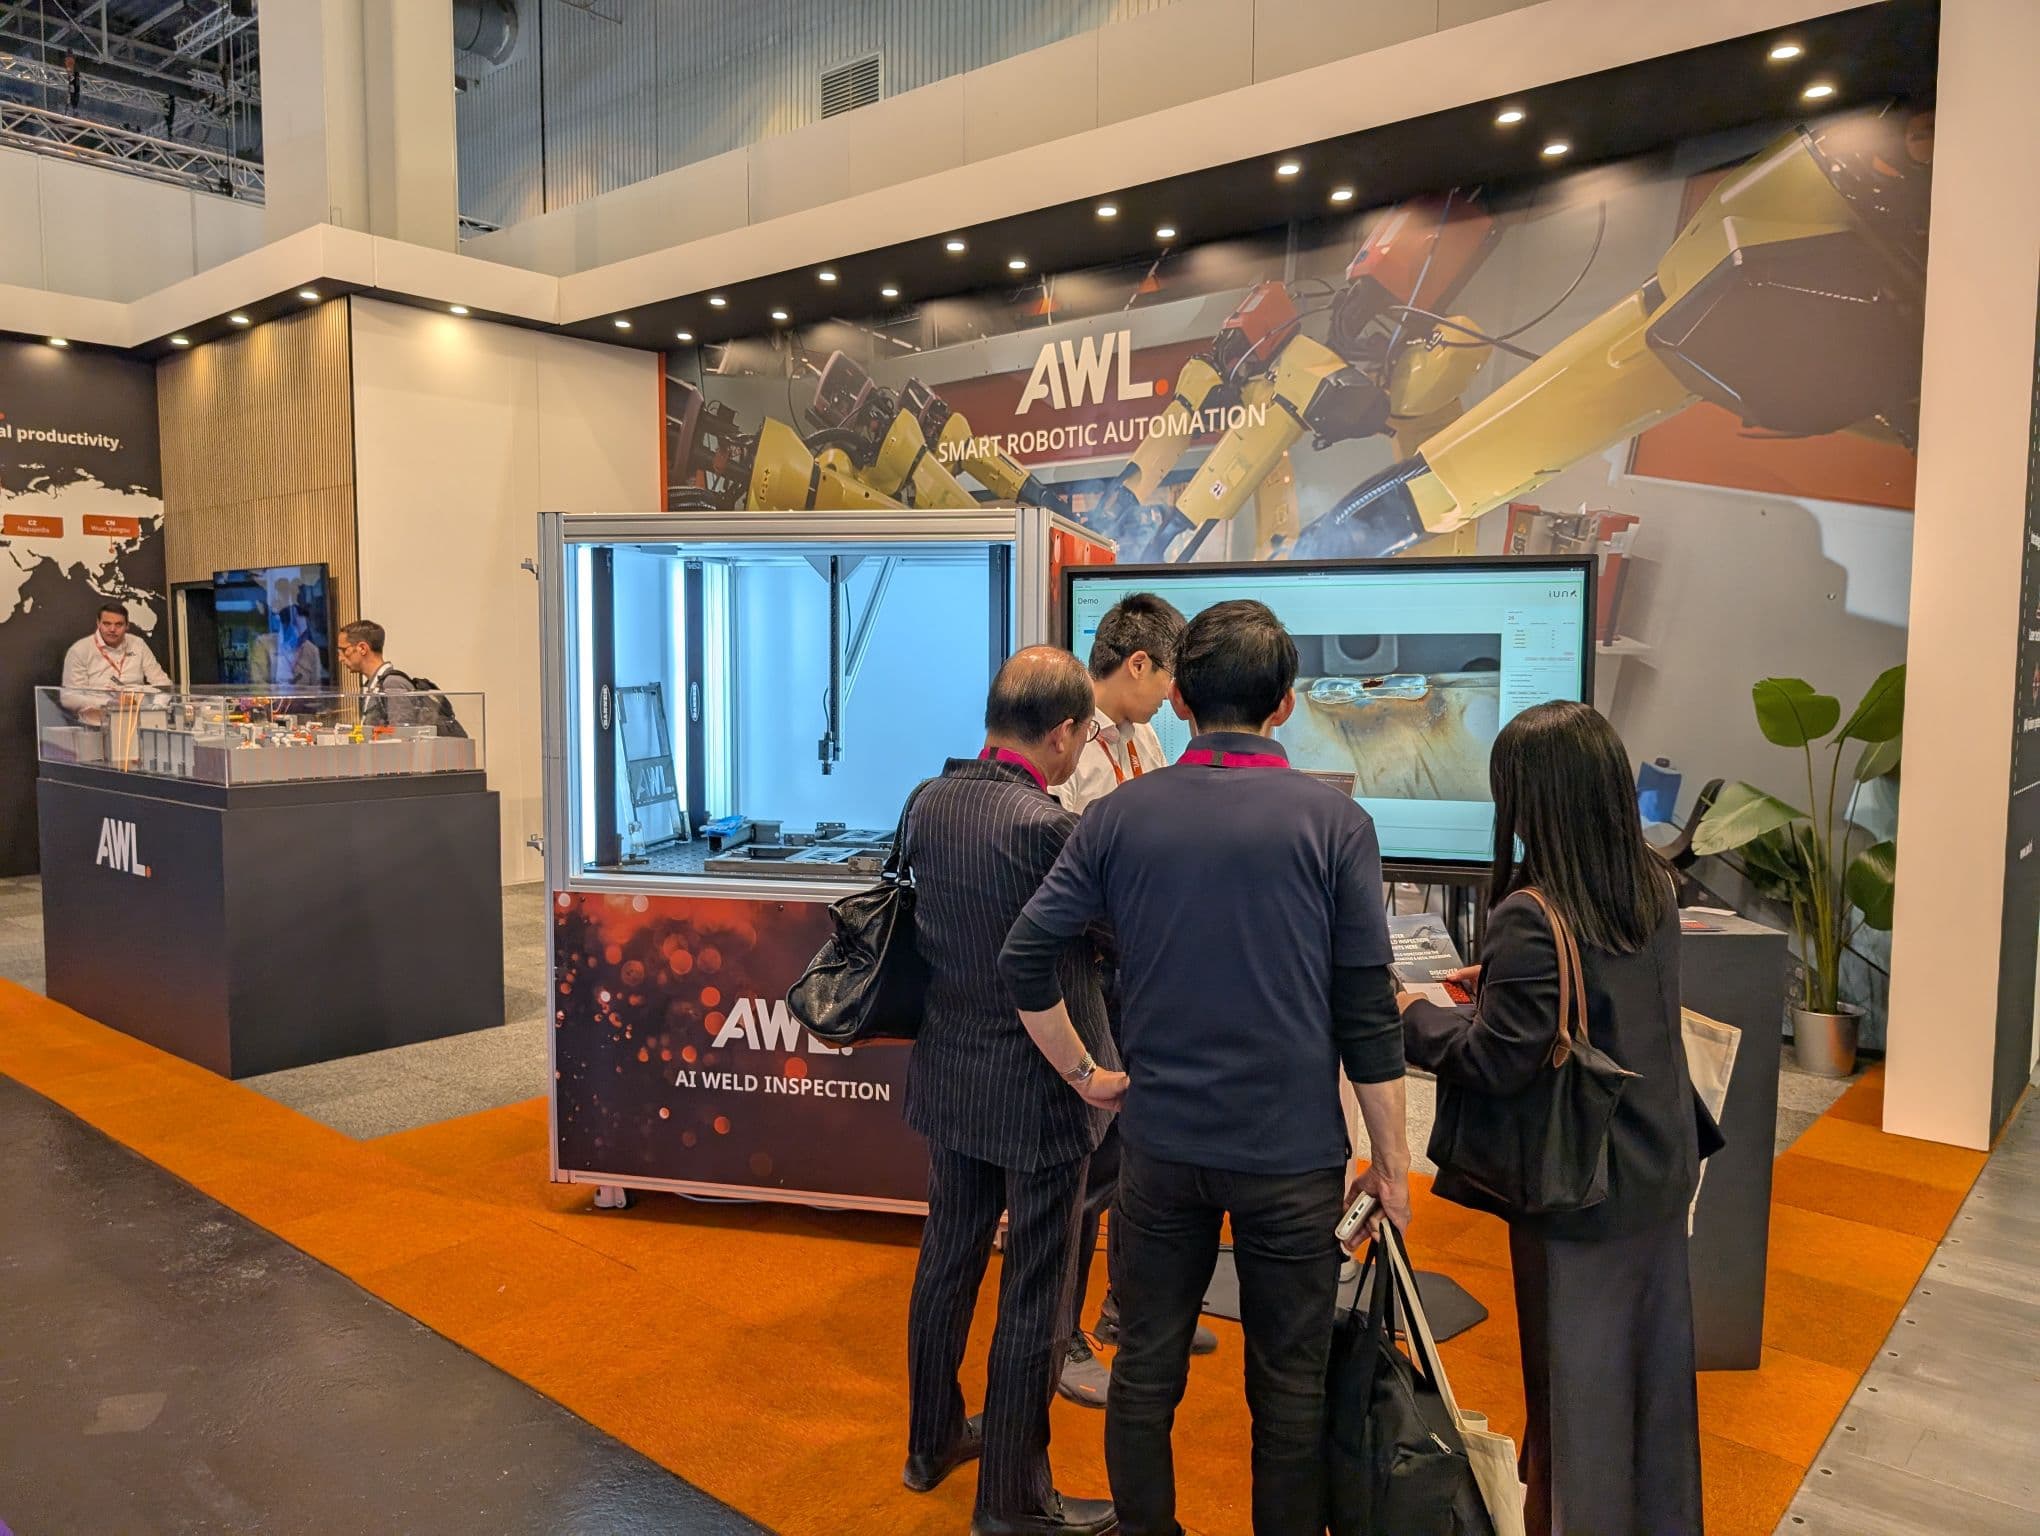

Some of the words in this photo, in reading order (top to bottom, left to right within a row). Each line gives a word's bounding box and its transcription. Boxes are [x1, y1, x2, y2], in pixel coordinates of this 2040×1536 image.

[938, 434, 1002, 463] SMART
[1007, 423, 1098, 456] ROBOTIC
[1103, 403, 1266, 445] AUTOMATION
[1077, 597, 1099, 605] Demo
[675, 1070, 696, 1088] AI
[701, 1072, 758, 1092] WELD
[764, 1075, 890, 1102] INSPECTION
